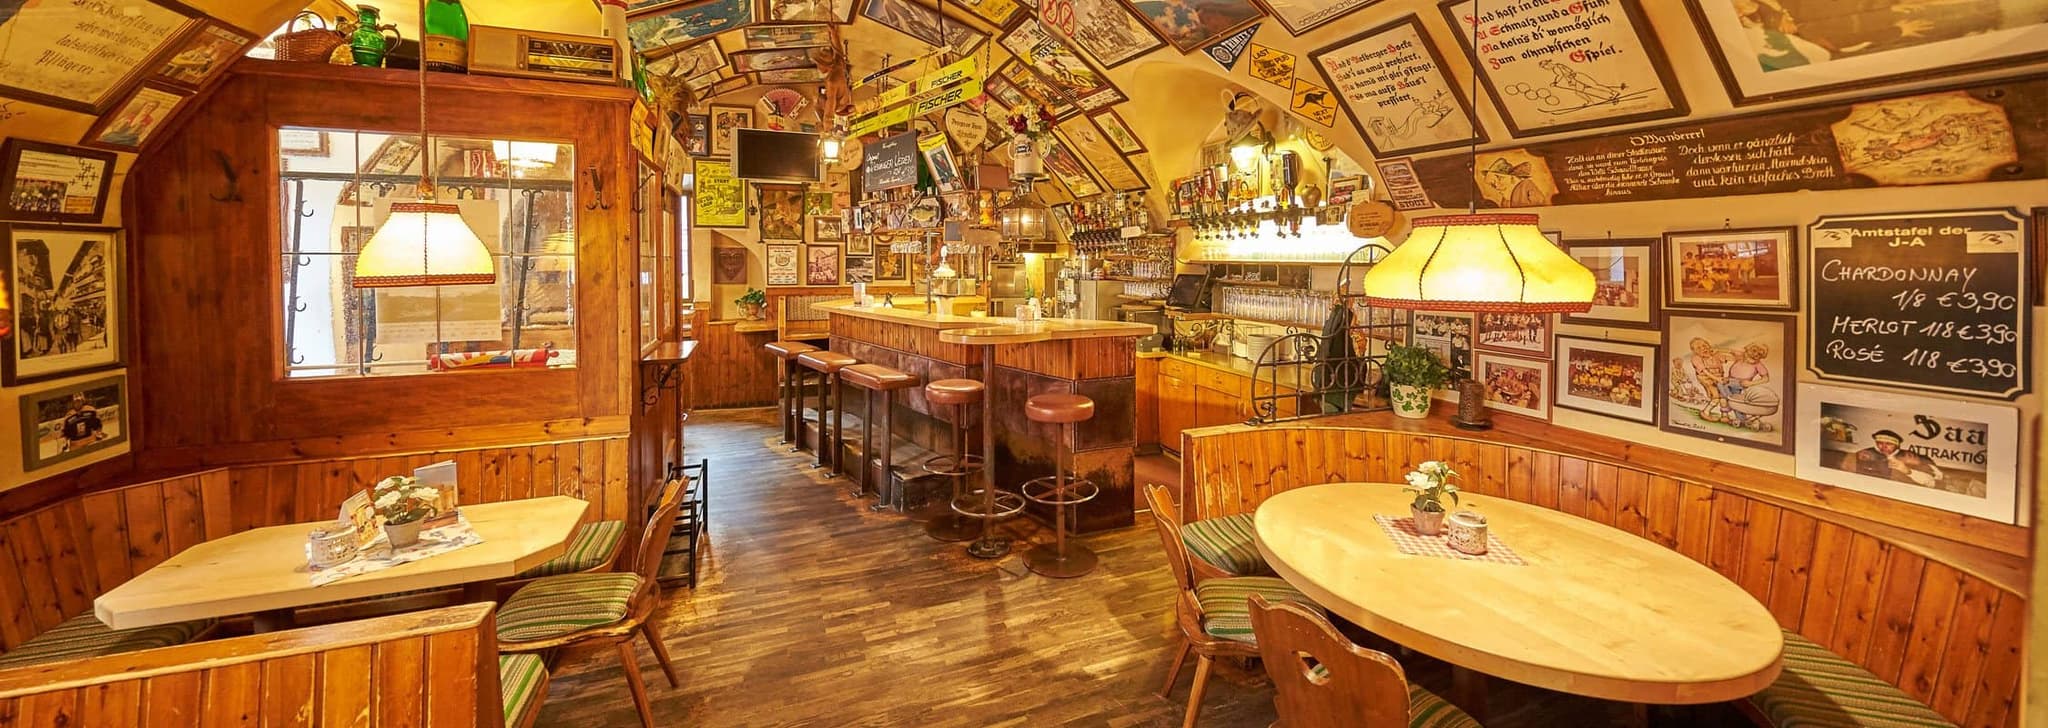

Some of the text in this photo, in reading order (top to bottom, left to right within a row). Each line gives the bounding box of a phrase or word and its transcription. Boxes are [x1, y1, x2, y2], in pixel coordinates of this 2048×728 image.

[1538, 10, 1560, 22] und
[1546, 11, 1610, 36] womöglich
[931, 70, 962, 88] FISCHER
[918, 88, 962, 112] FISCHER
[1678, 144, 1704, 156] Doch
[1851, 226, 1971, 238] Amtstafel der
[1889, 237, 1925, 248] J-A
[1822, 260, 1977, 292] CHARDONNAY
[1892, 289, 1926, 311] 1/8
[1920, 322, 1954, 338] 1/8
[1826, 340, 1884, 362] ROSÉ
[1902, 348, 1940, 368] 1/8
